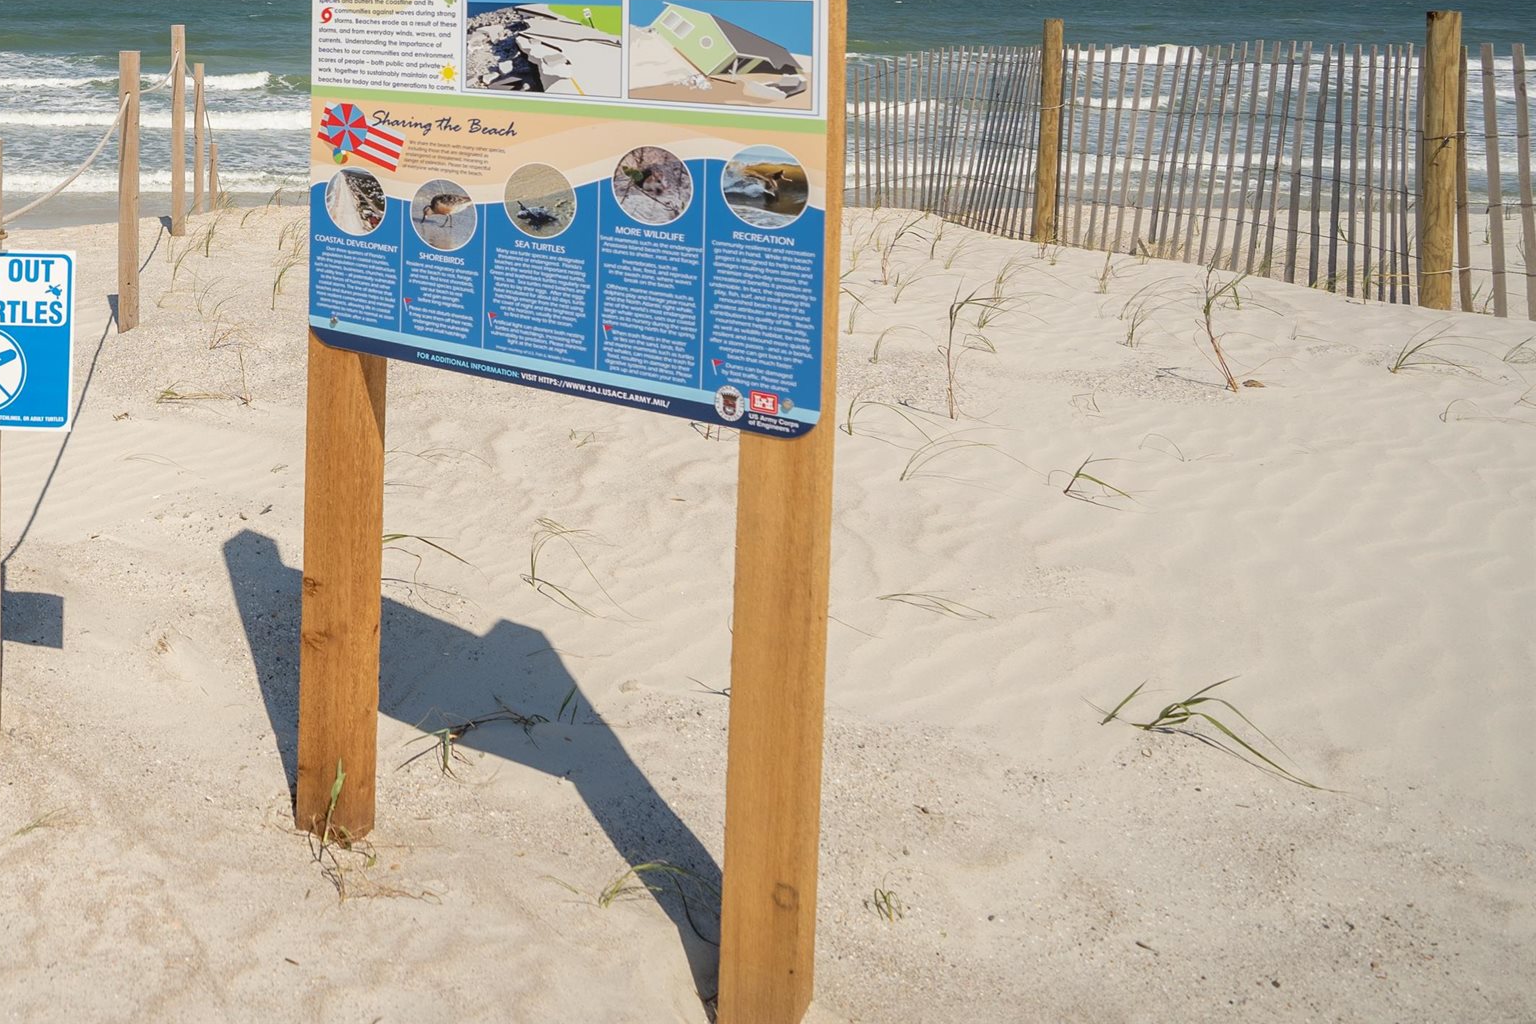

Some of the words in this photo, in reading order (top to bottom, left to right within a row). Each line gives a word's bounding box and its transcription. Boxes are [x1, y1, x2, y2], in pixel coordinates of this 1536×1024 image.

[372, 110, 432, 136] Sharing
[436, 117, 461, 132] the
[468, 118, 517, 136] Beach
[615, 226, 641, 236] MORE
[644, 230, 684, 242] WILDLIFE
[733, 231, 794, 246] RECREATION
[315, 234, 345, 245] COASTAL
[347, 239, 398, 253] DEVELOPMENT
[515, 240, 530, 249] SEA
[532, 242, 565, 253] TURTLES
[419, 252, 464, 265] SHOREBIRDS
[8, 259, 54, 283] OUT
[417, 351, 429, 360] FOR
[430, 353, 469, 367] ADDITIONAL
[521, 372, 537, 382] VISIT
[757, 421, 790, 432] Engineers
[761, 415, 777, 424] Army
[779, 418, 799, 428] Corps
